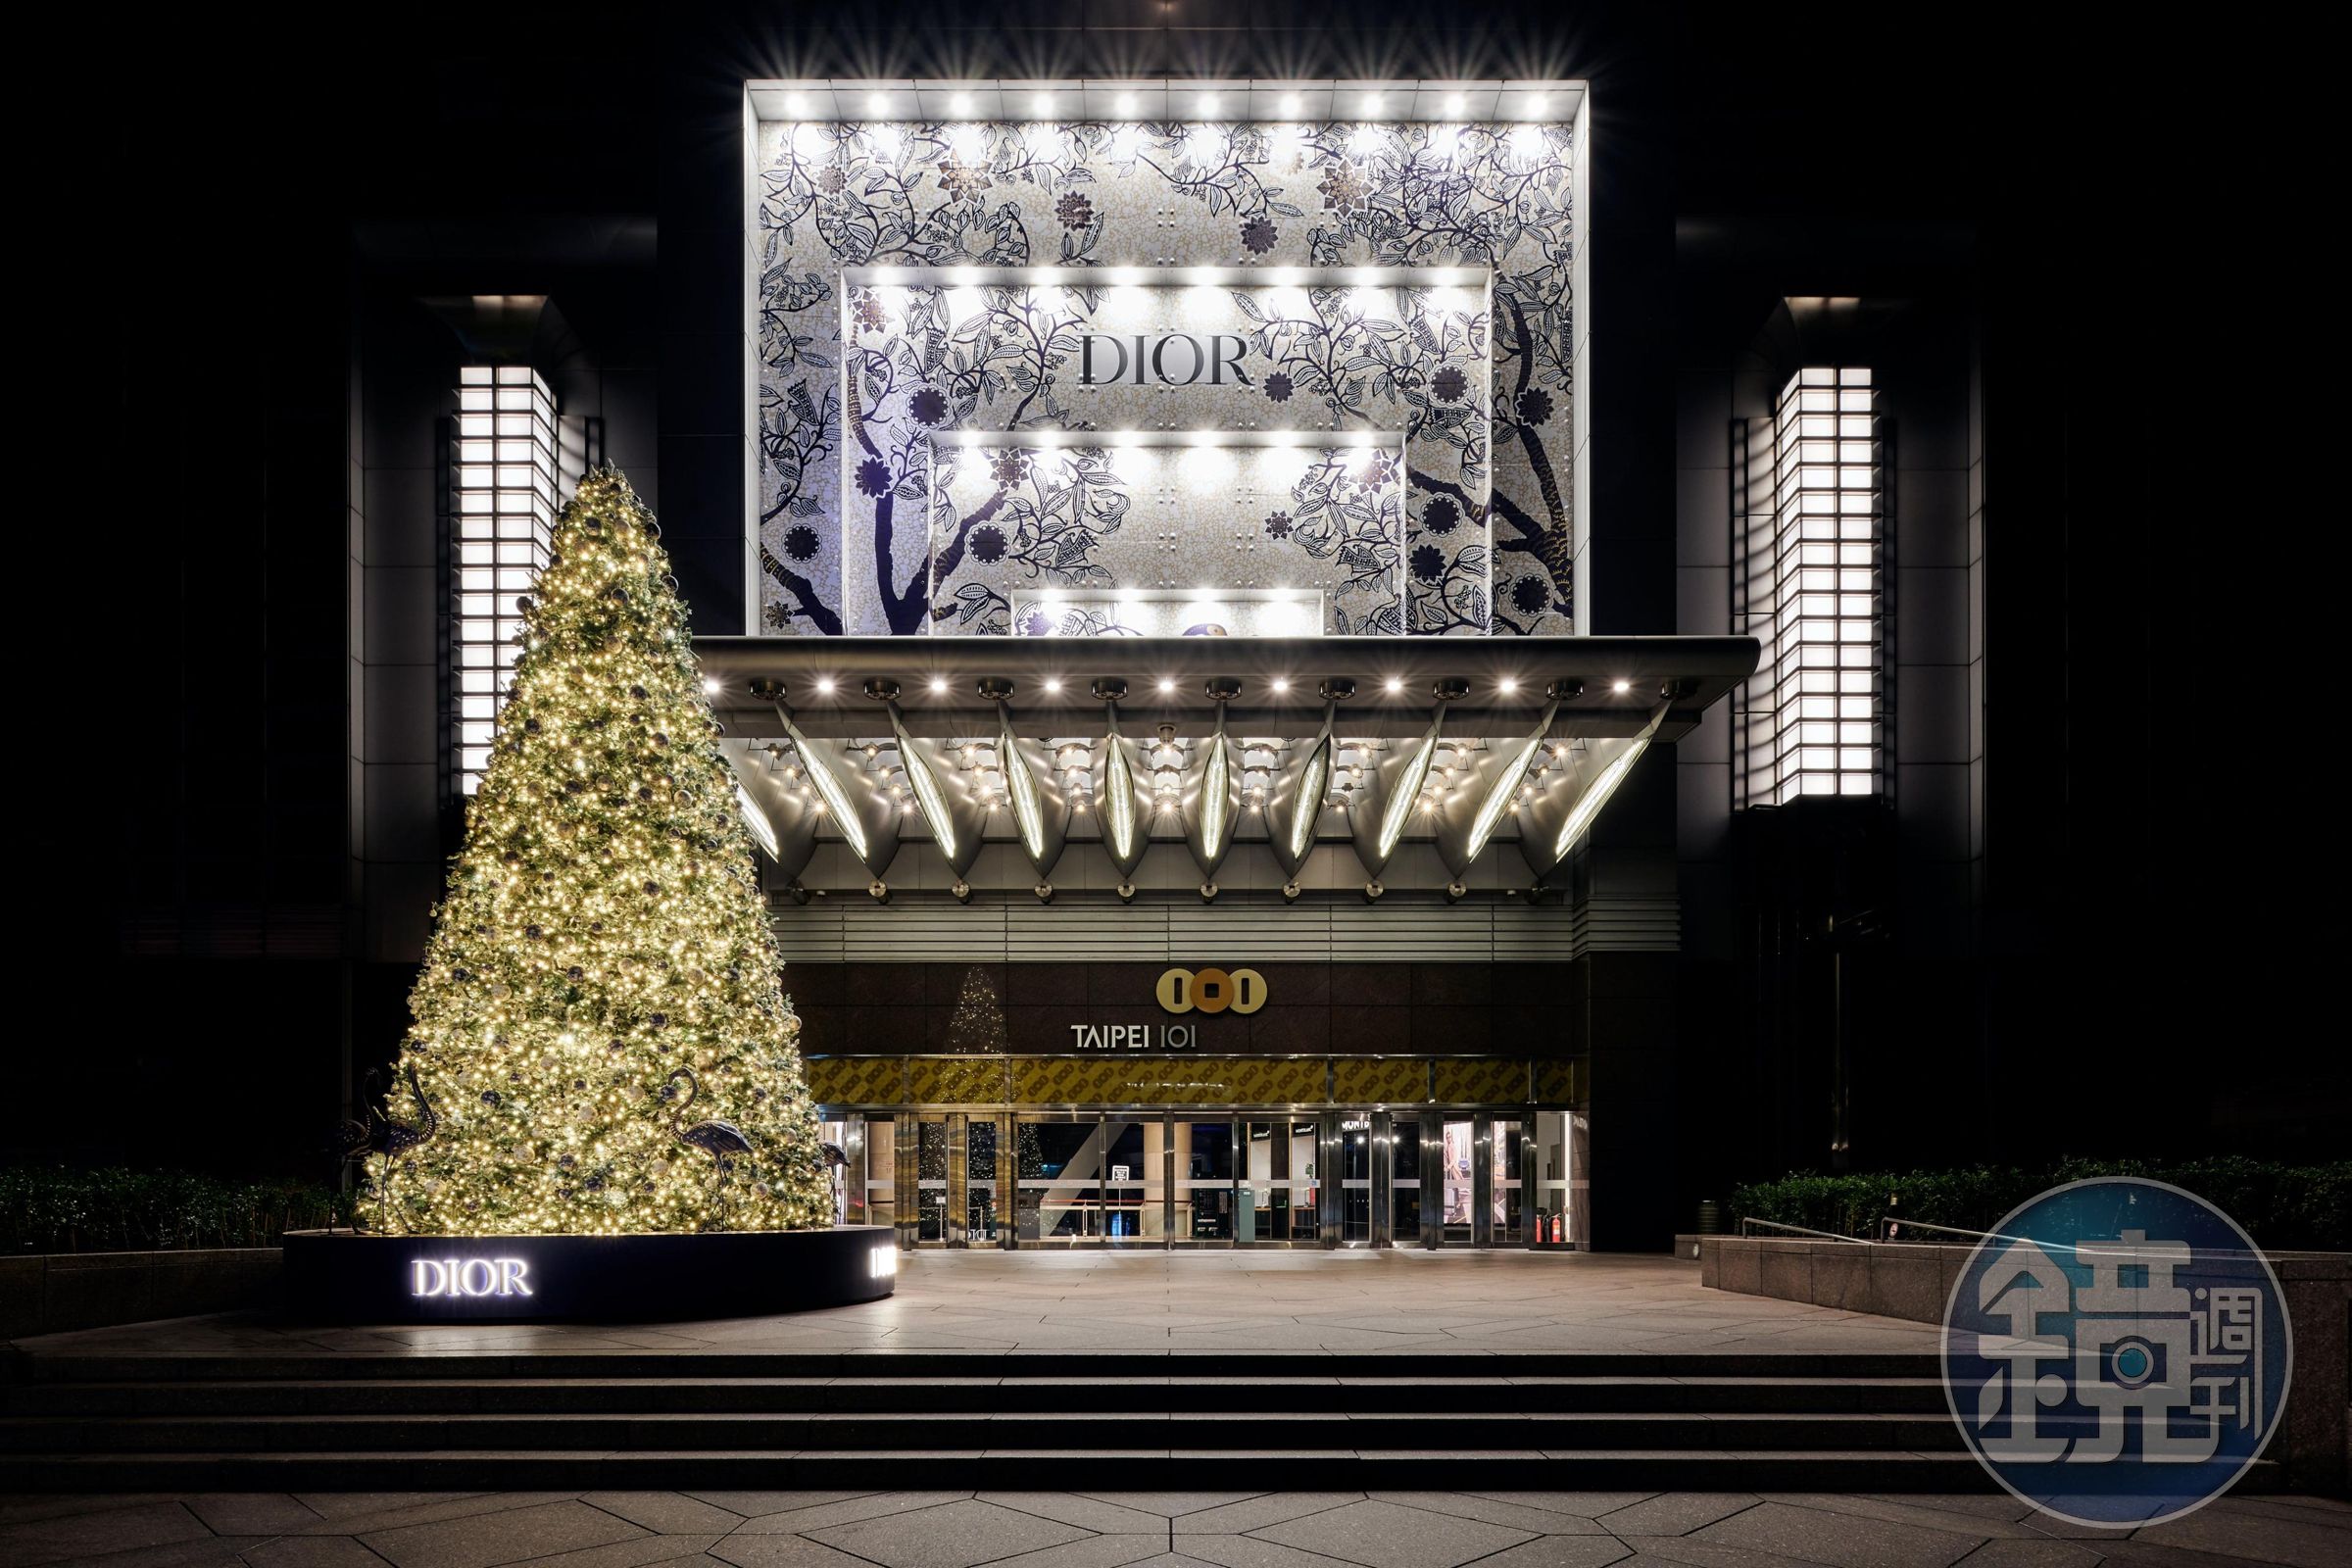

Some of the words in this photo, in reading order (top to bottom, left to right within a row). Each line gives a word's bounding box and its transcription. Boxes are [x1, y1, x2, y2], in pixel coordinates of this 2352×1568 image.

[1076, 334, 1255, 386] DIOR
[1070, 1024, 1150, 1049] TAIPEI
[412, 1259, 533, 1297] DIOR
